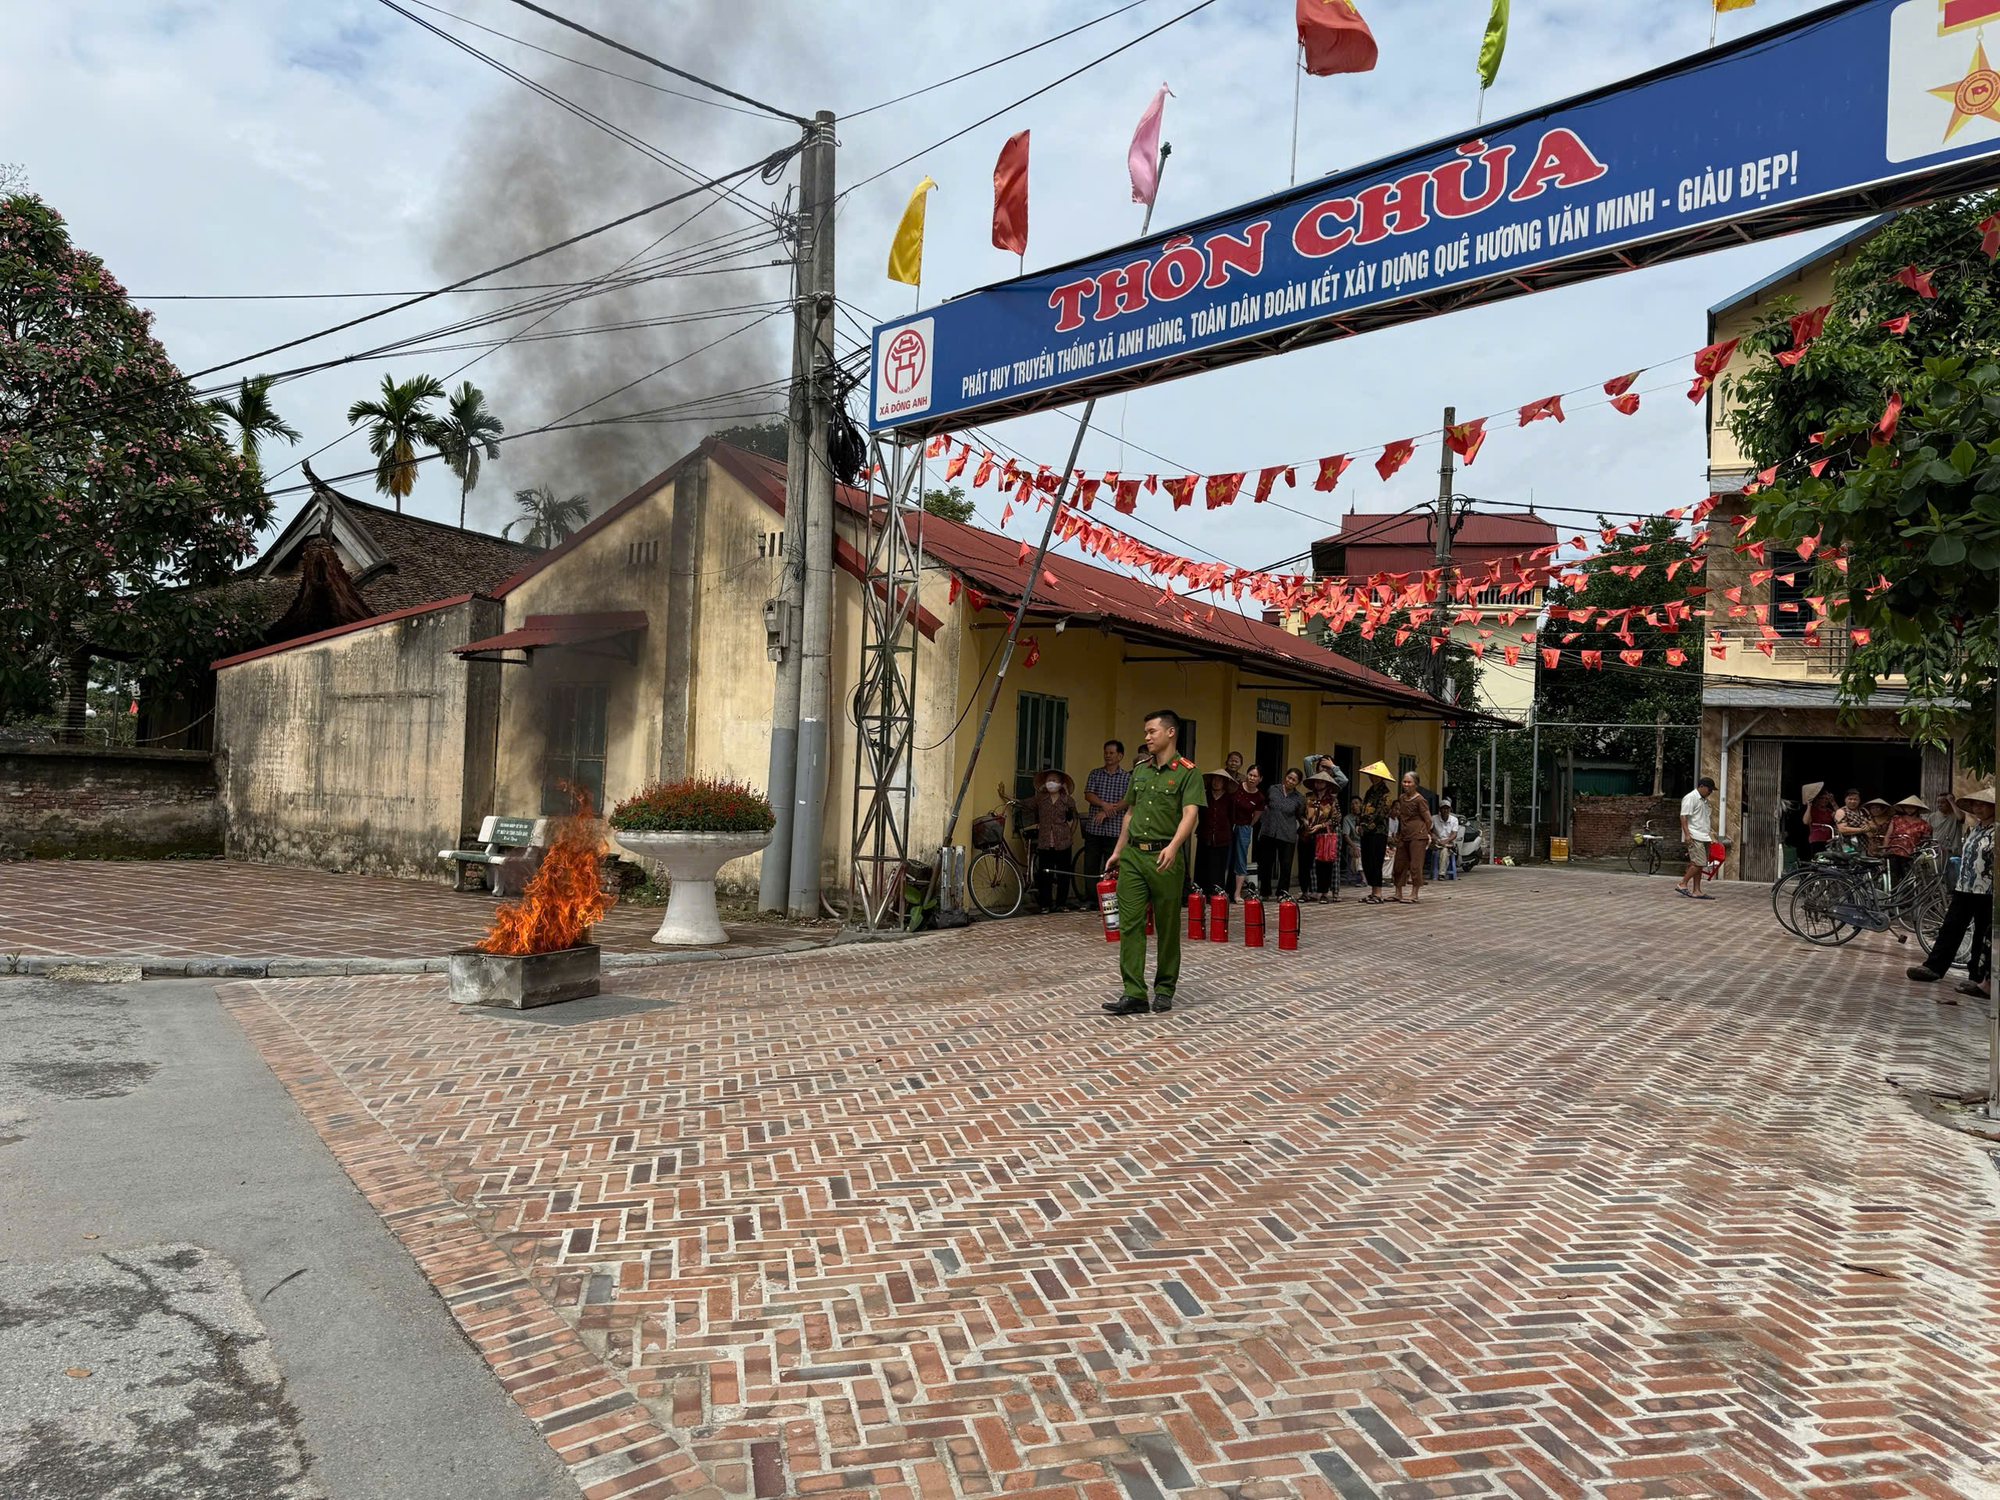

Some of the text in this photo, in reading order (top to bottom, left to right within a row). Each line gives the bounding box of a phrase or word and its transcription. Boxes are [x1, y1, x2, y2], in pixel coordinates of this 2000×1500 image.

[961, 368, 988, 400] PHÁT
[989, 364, 1011, 393] HUY
[1012, 346, 1054, 386] TRUYỀN
[1057, 336, 1096, 375] THỐNG
[1097, 331, 1115, 365] XÃ
[1117, 327, 1144, 360] ANH
[1146, 315, 1188, 352] HÙNG,
[1190, 302, 1227, 339] TOÀN
[1230, 293, 1262, 329] DÂN
[1264, 280, 1307, 320] ĐOÀN
[1310, 264, 1341, 308] KẾT
[1343, 260, 1378, 299] XÂY
[1381, 248, 1430, 293] DỰNG
[1434, 232, 1471, 279] QUÊ
[1475, 219, 1542, 266] HƯƠNG
[1547, 204, 1590, 247] VĂN
[1595, 188, 1656, 235] MINH
[1677, 165, 1733, 213] GIÀU
[1739, 150, 1799, 201] ĐẸP!
[1048, 221, 1272, 333] THÔN
[879, 396, 928, 416] XÃ ĐÔNG ANH
[1258, 709, 1274, 724] THÔN
